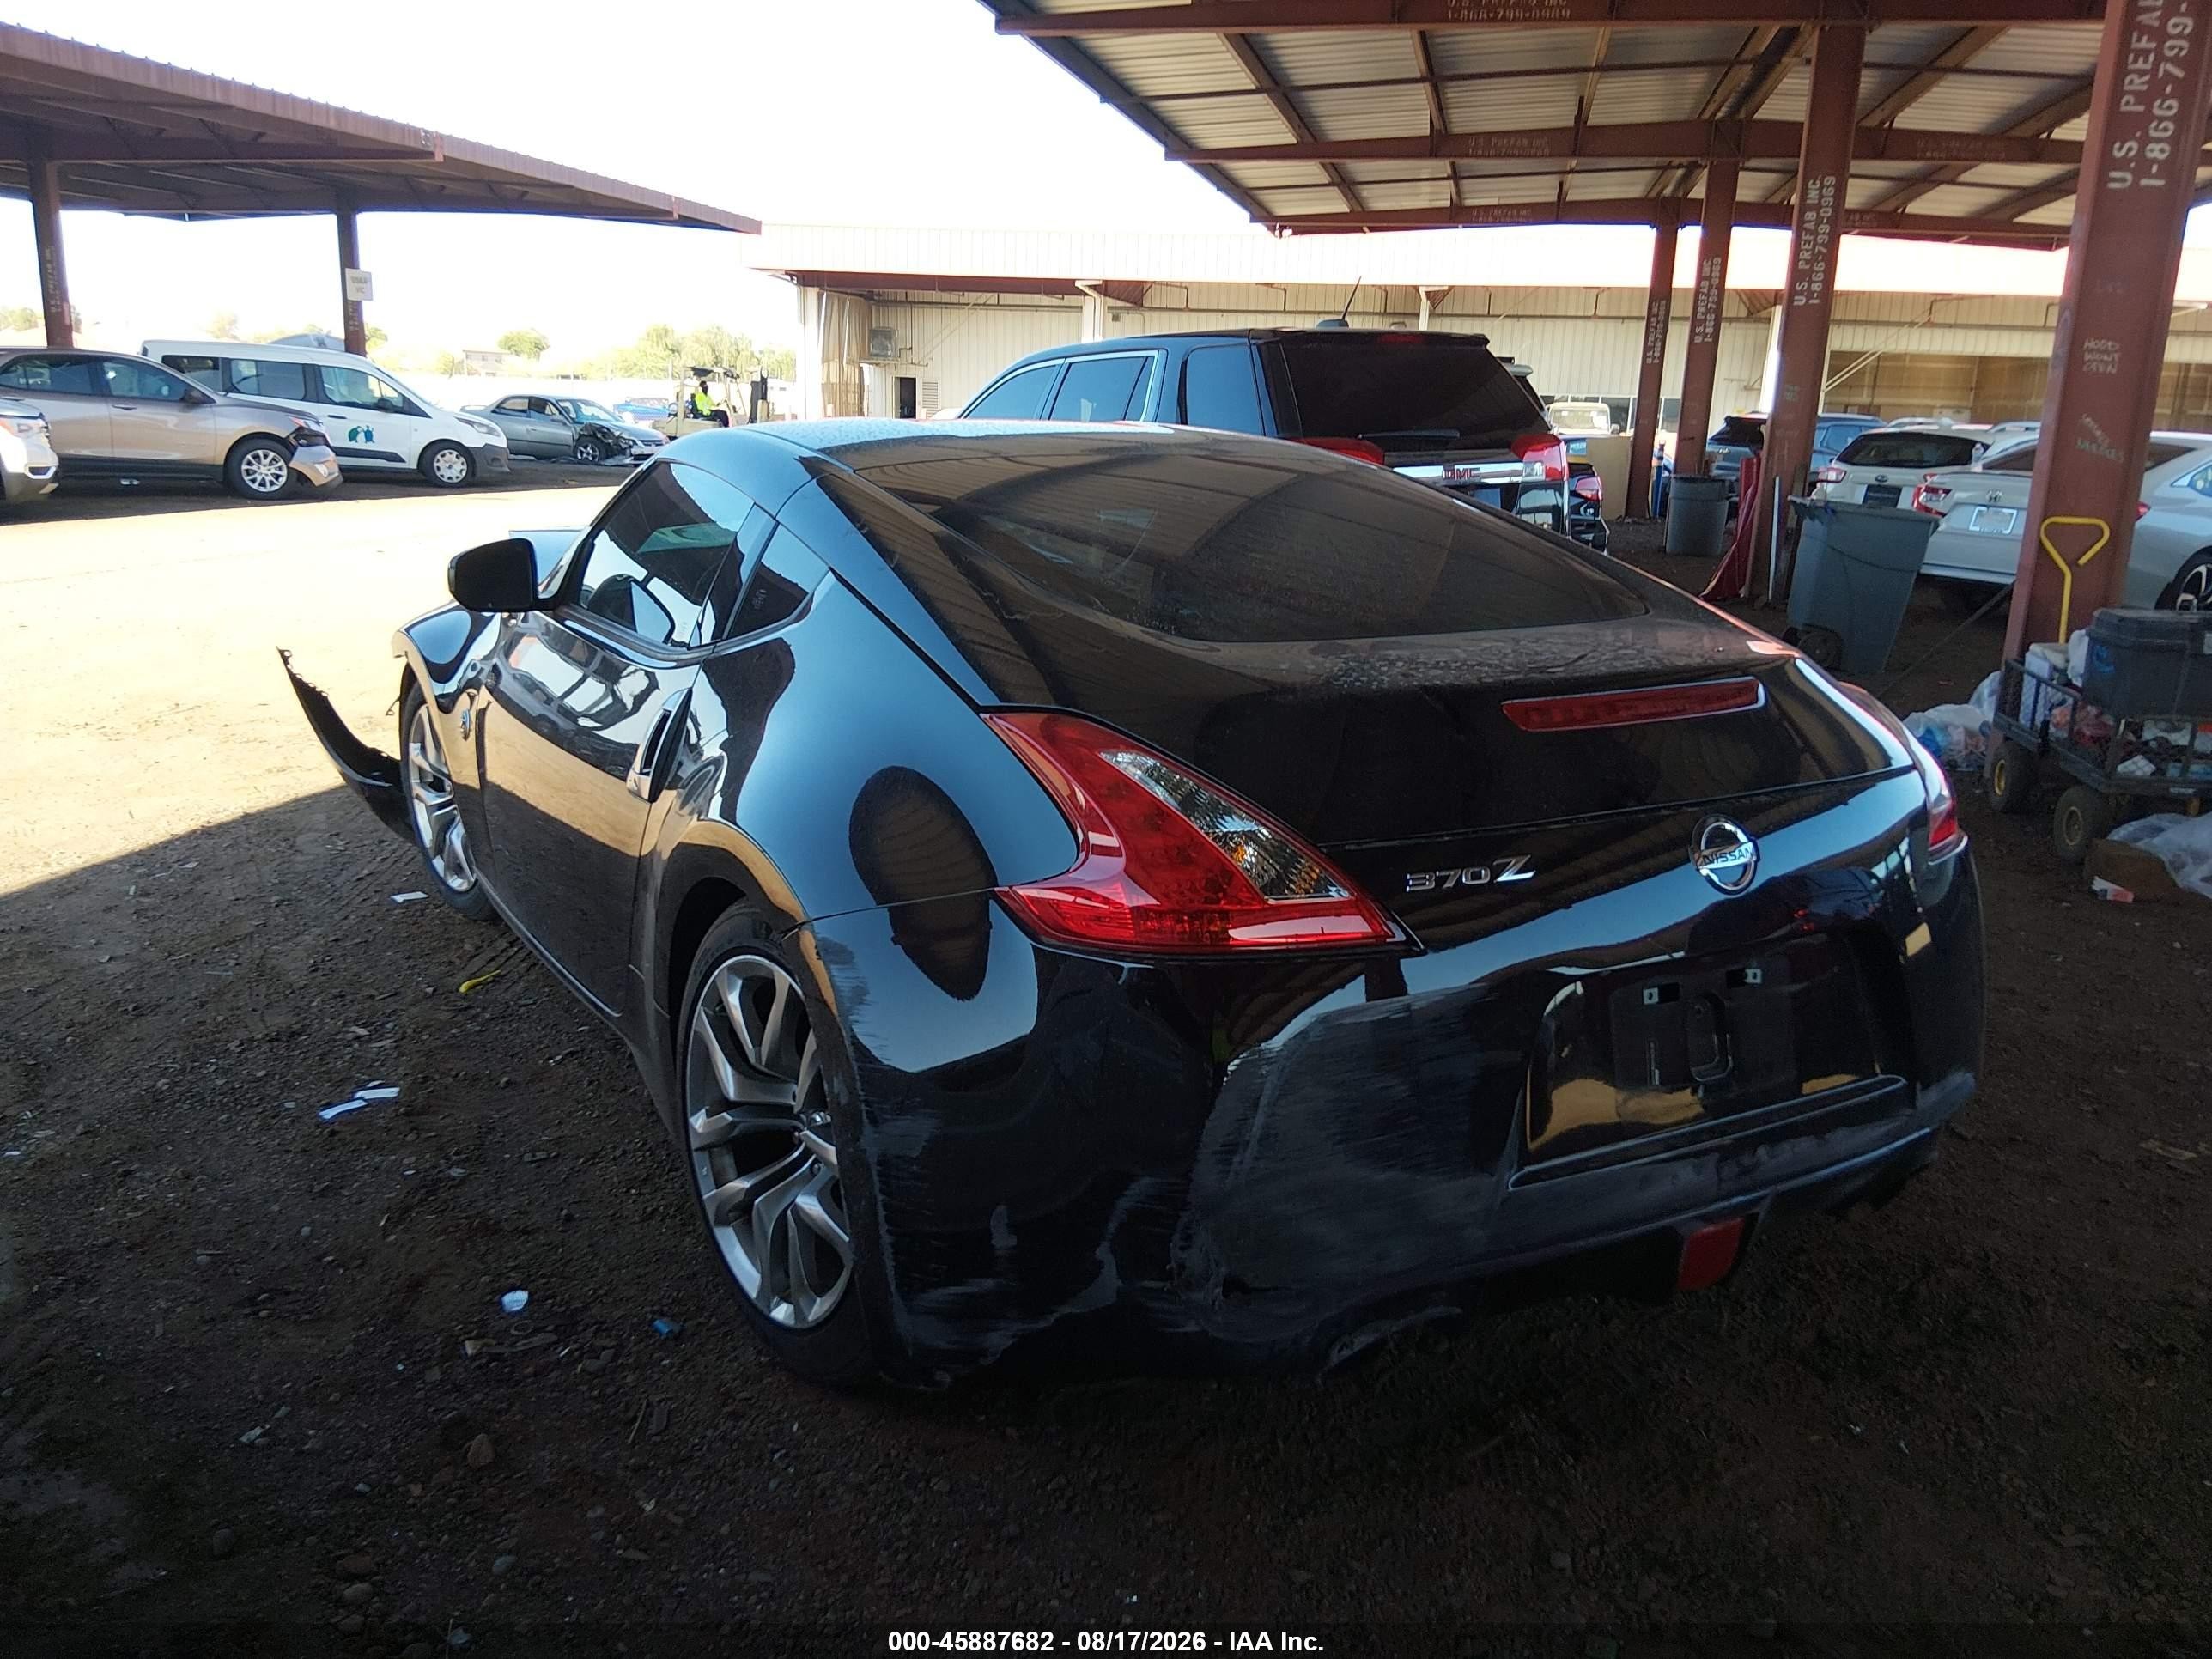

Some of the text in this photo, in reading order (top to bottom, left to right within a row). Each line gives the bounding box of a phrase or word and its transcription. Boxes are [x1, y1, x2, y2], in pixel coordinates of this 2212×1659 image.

[2107, 131, 2142, 189] U.S.
[1793, 174, 1822, 307] U.S. PREFAB INC.
[1808, 175, 1836, 305] 1-866-799-0969
[1697, 280, 1709, 319] PREFAB
[1406, 854, 1536, 893] 370Z
[1702, 846, 1753, 865] NISSAN
